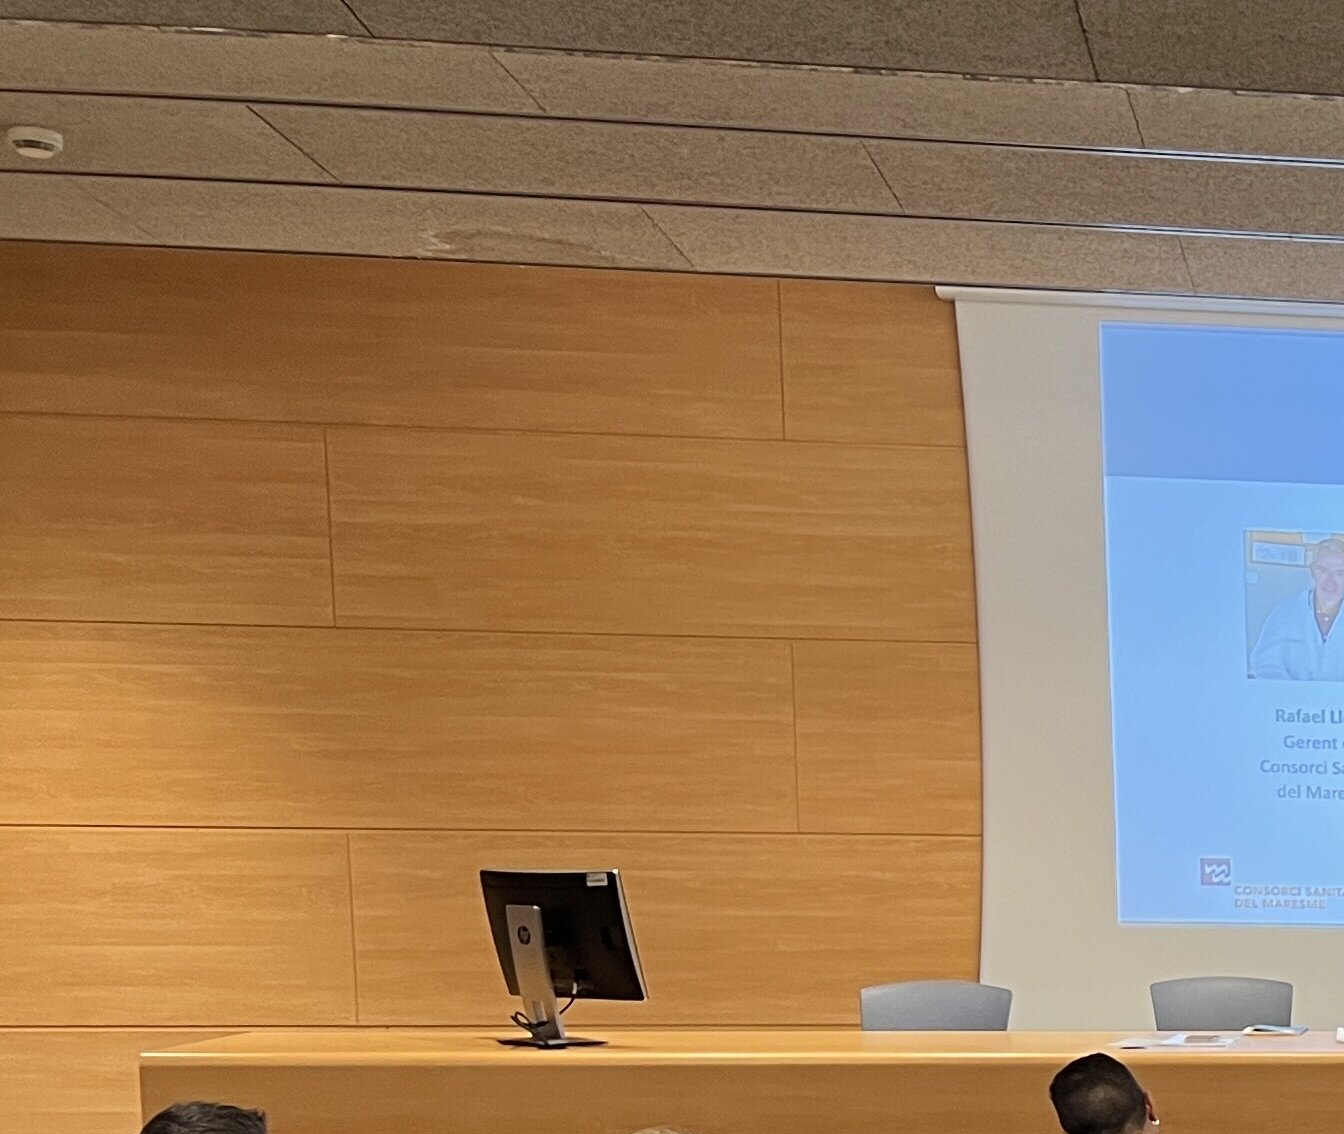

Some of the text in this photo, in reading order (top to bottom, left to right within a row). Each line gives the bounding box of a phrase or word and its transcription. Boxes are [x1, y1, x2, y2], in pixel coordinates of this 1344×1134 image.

[1275, 708, 1326, 724] Rafael
[1283, 735, 1338, 750] Gerent
[1260, 759, 1329, 775] Consorci
[1277, 784, 1302, 799] del
[1234, 885, 1302, 897] CONSORCI
[1234, 899, 1326, 910] DEL MARESME
